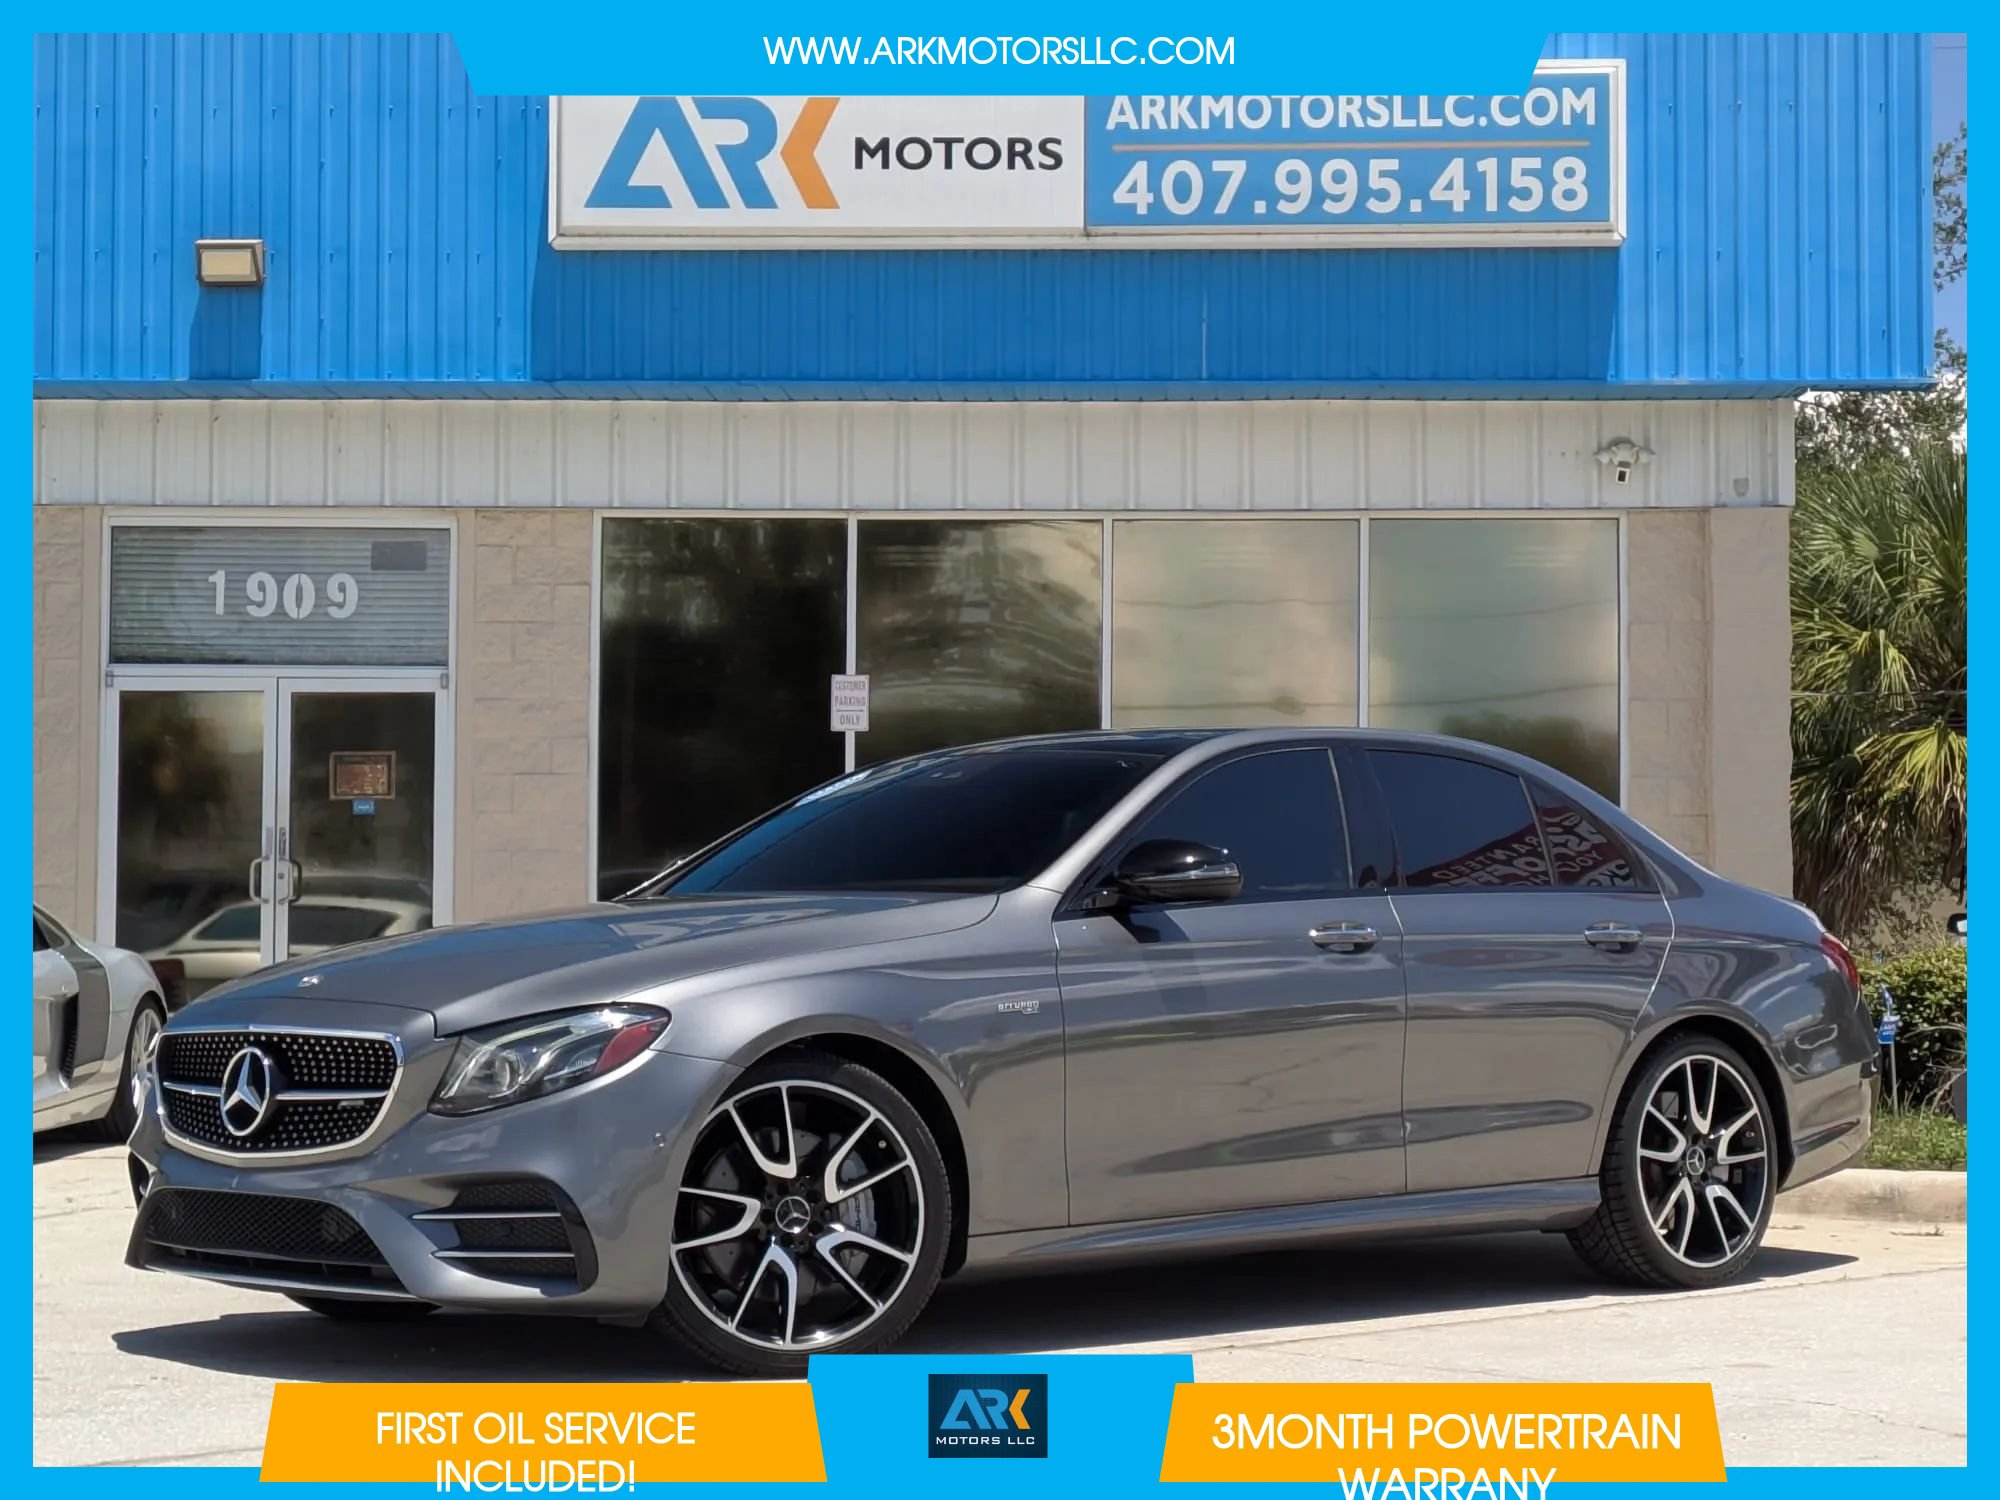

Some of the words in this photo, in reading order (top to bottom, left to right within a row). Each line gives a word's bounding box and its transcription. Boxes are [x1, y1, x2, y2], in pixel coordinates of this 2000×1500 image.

[1106, 87, 1595, 130] ARKMOTORSLLC.COM
[583, 96, 840, 209] ARK
[854, 136, 1063, 171] MOTORS
[1113, 156, 1588, 215] 407.995.4158
[208, 570, 358, 620] 1909
[834, 696, 866, 706] PARKING
[835, 680, 865, 691] CUSTOMER
[839, 715, 861, 726] ONLY
